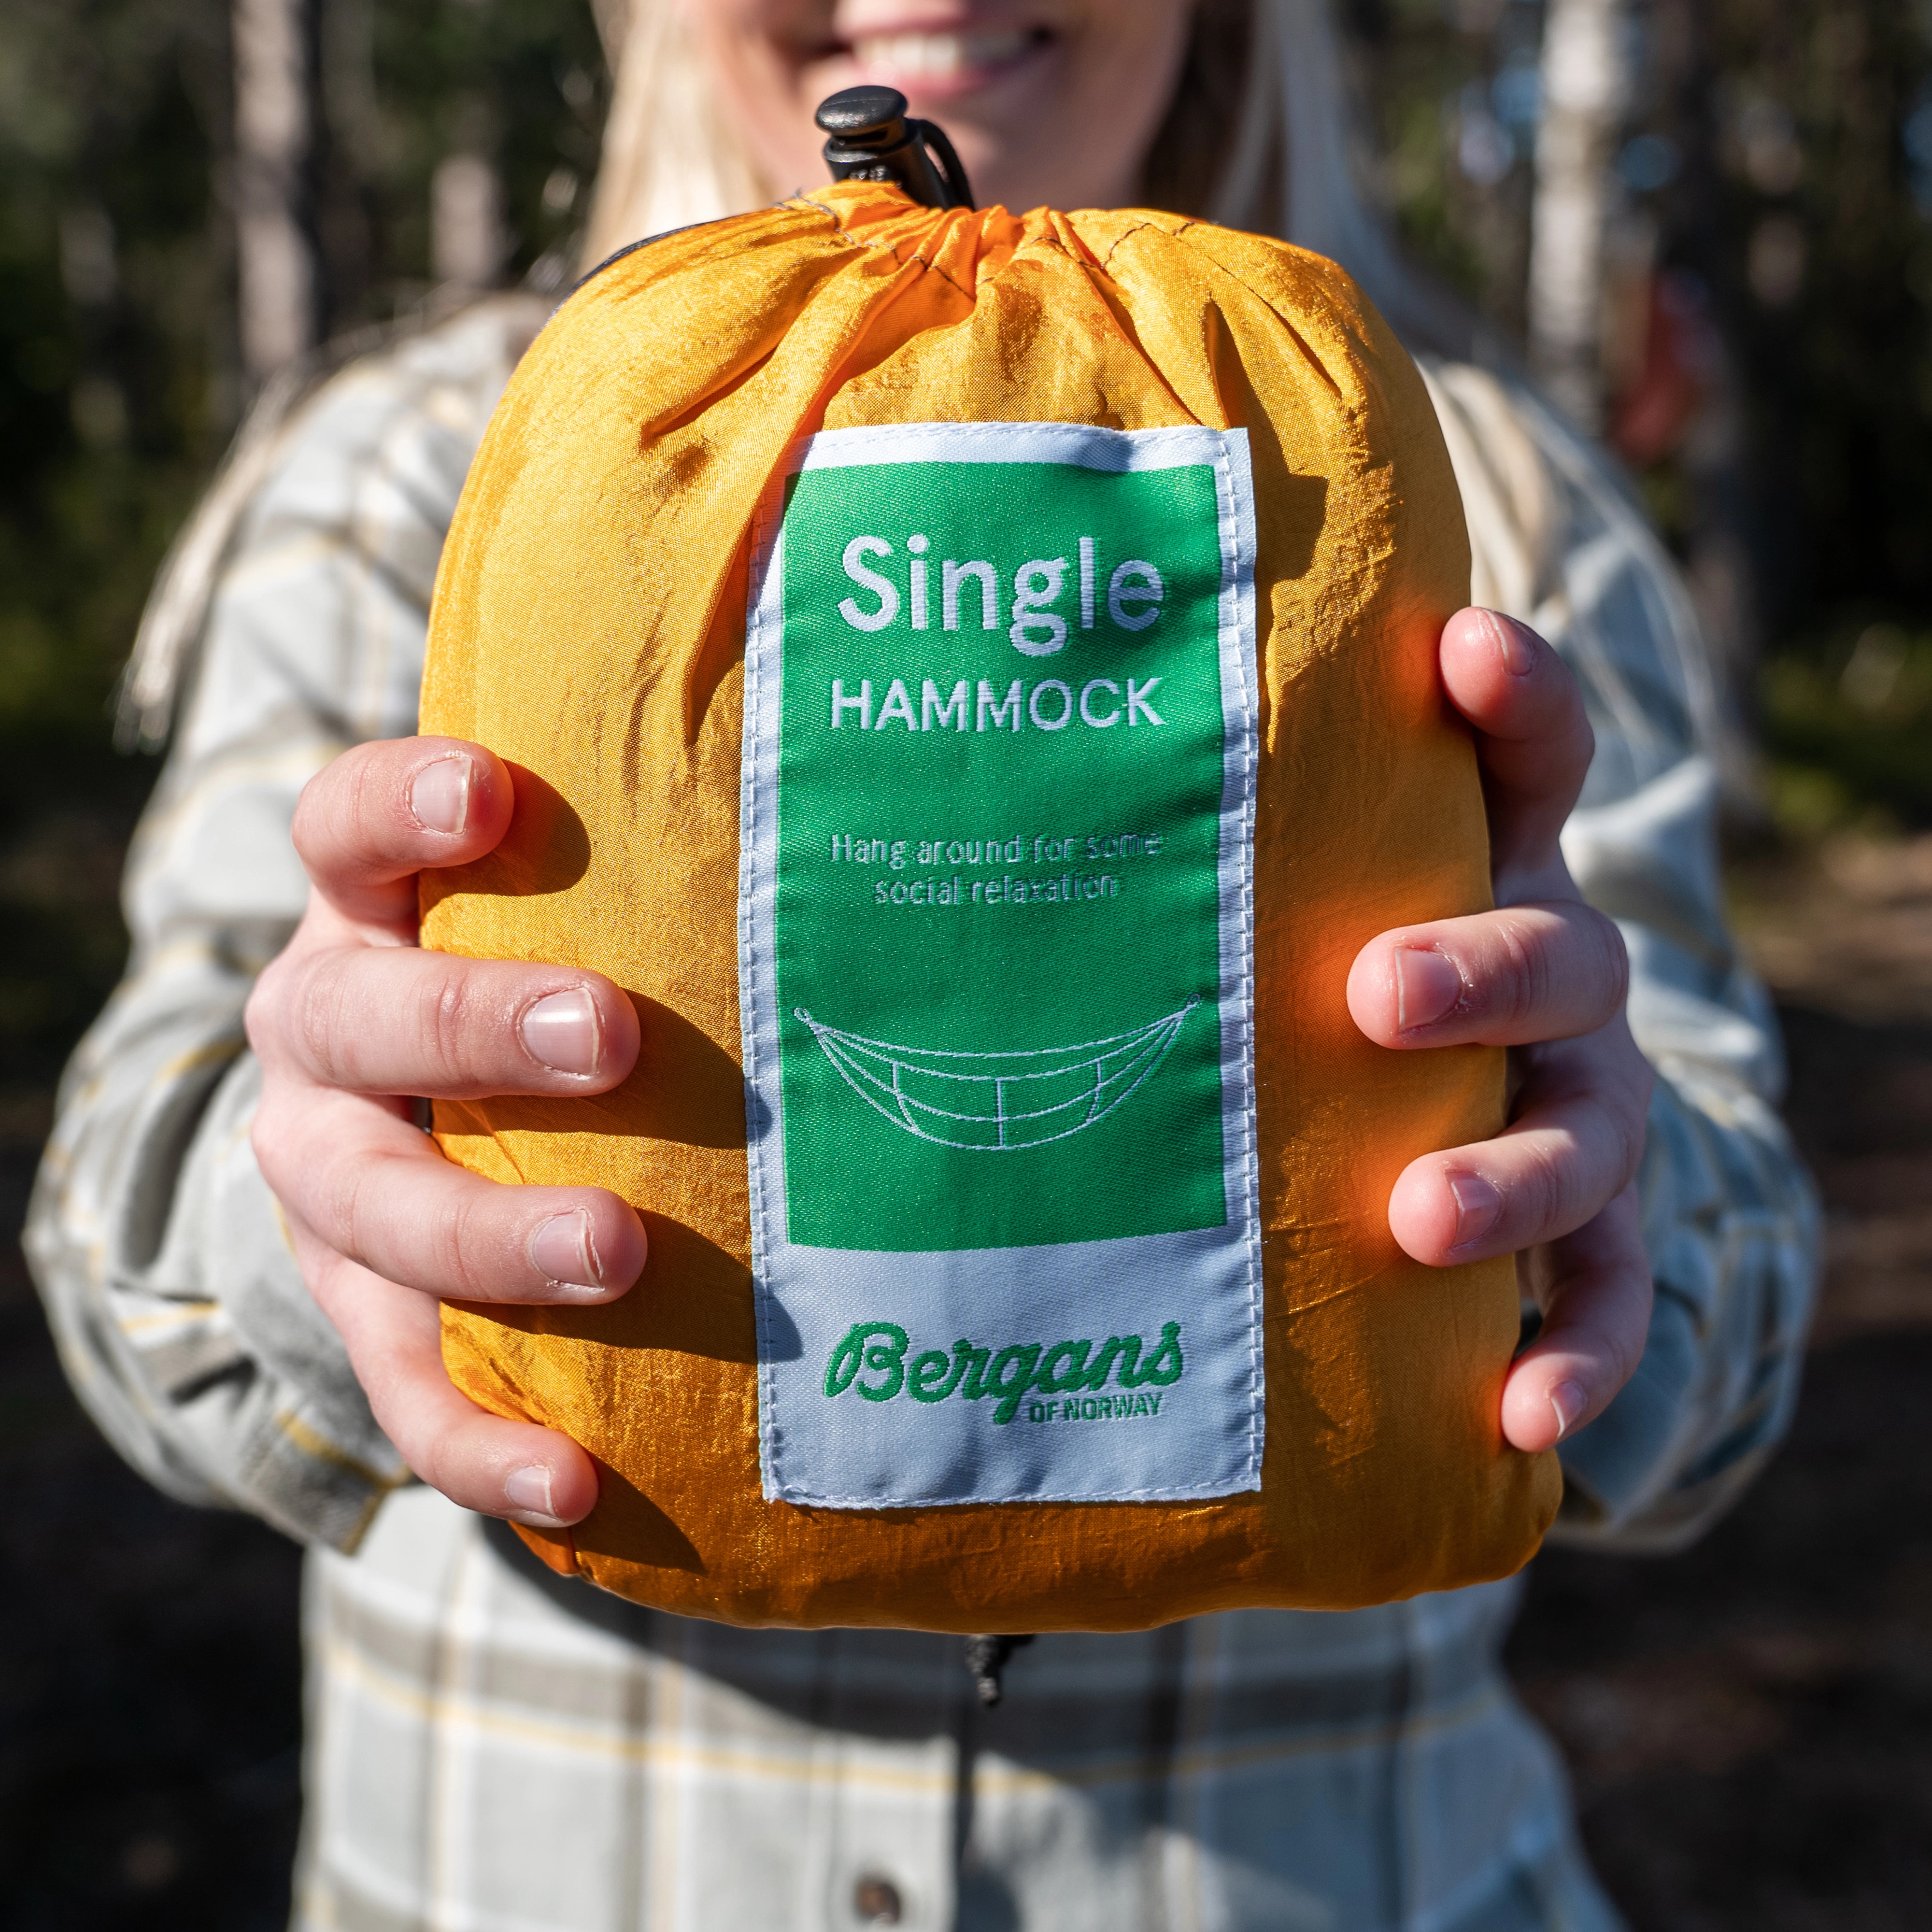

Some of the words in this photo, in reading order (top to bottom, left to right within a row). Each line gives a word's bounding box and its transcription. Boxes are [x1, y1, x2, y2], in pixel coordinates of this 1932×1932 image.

[838, 534, 1164, 657] Single
[831, 678, 1165, 731] HAMMOCK
[831, 834, 905, 869] Hang
[919, 835, 1021, 864] around
[1034, 835, 1074, 862] for
[1087, 833, 1160, 858] some
[874, 876, 958, 904] social
[972, 872, 1115, 904] relaxation
[824, 1321, 1183, 1425] Bergans
[1030, 1401, 1059, 1423] OF
[1065, 1393, 1163, 1421] NORWAY
